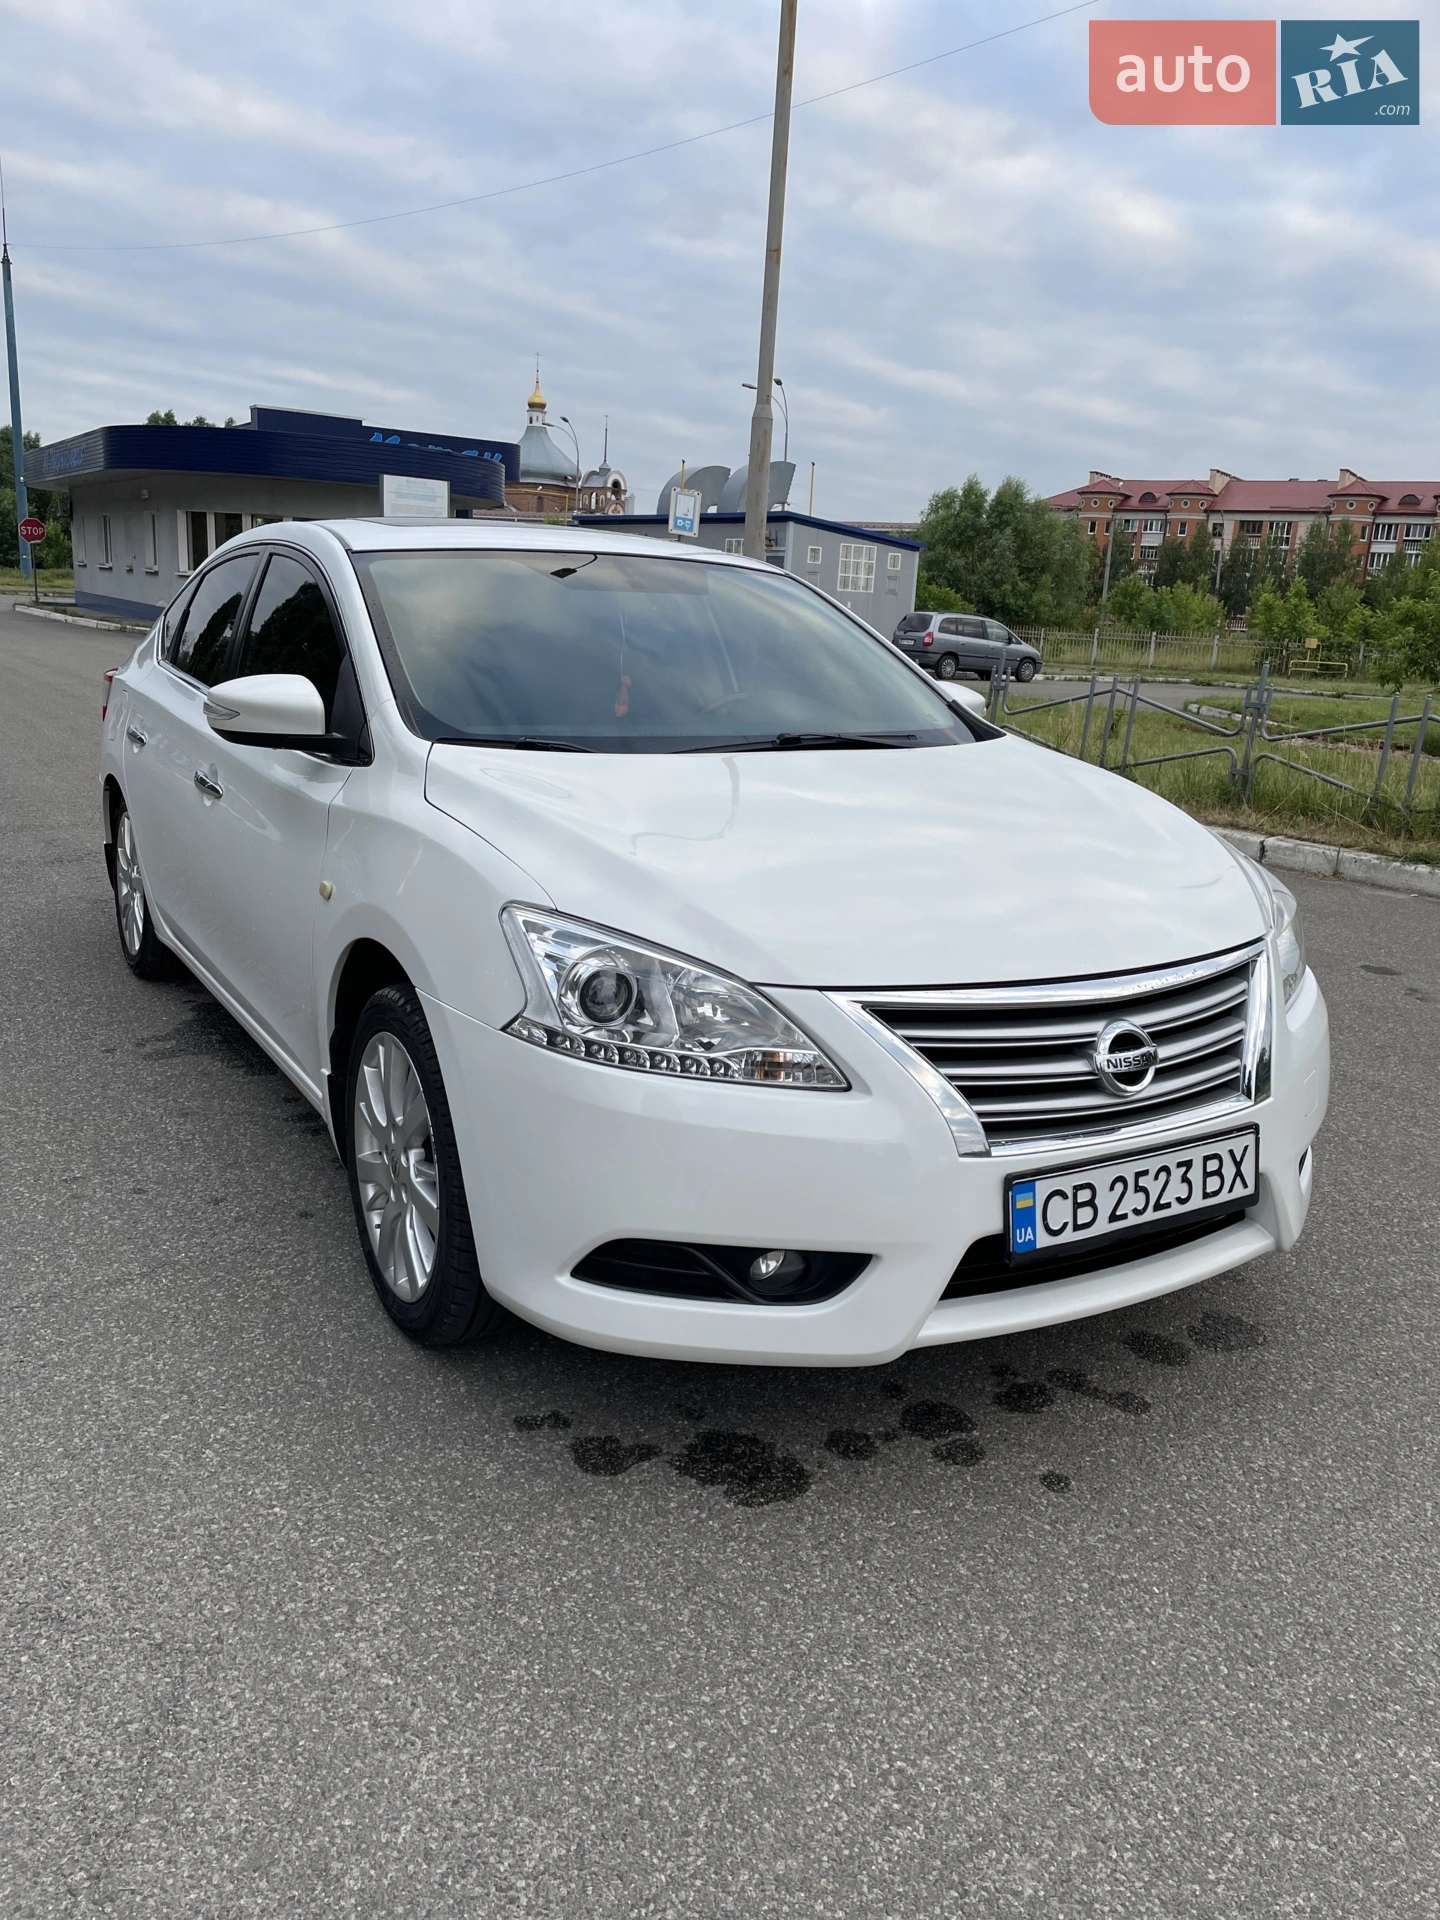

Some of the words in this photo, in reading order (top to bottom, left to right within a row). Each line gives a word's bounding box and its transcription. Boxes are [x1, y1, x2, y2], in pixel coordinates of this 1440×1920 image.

[21, 526, 44, 535] STOP
[1106, 1050, 1158, 1070] NISSAN
[1042, 1182, 1099, 1236] CB
[1108, 1158, 1194, 1224] 2523
[1202, 1144, 1249, 1199] BX
[1016, 1227, 1034, 1243] UA
